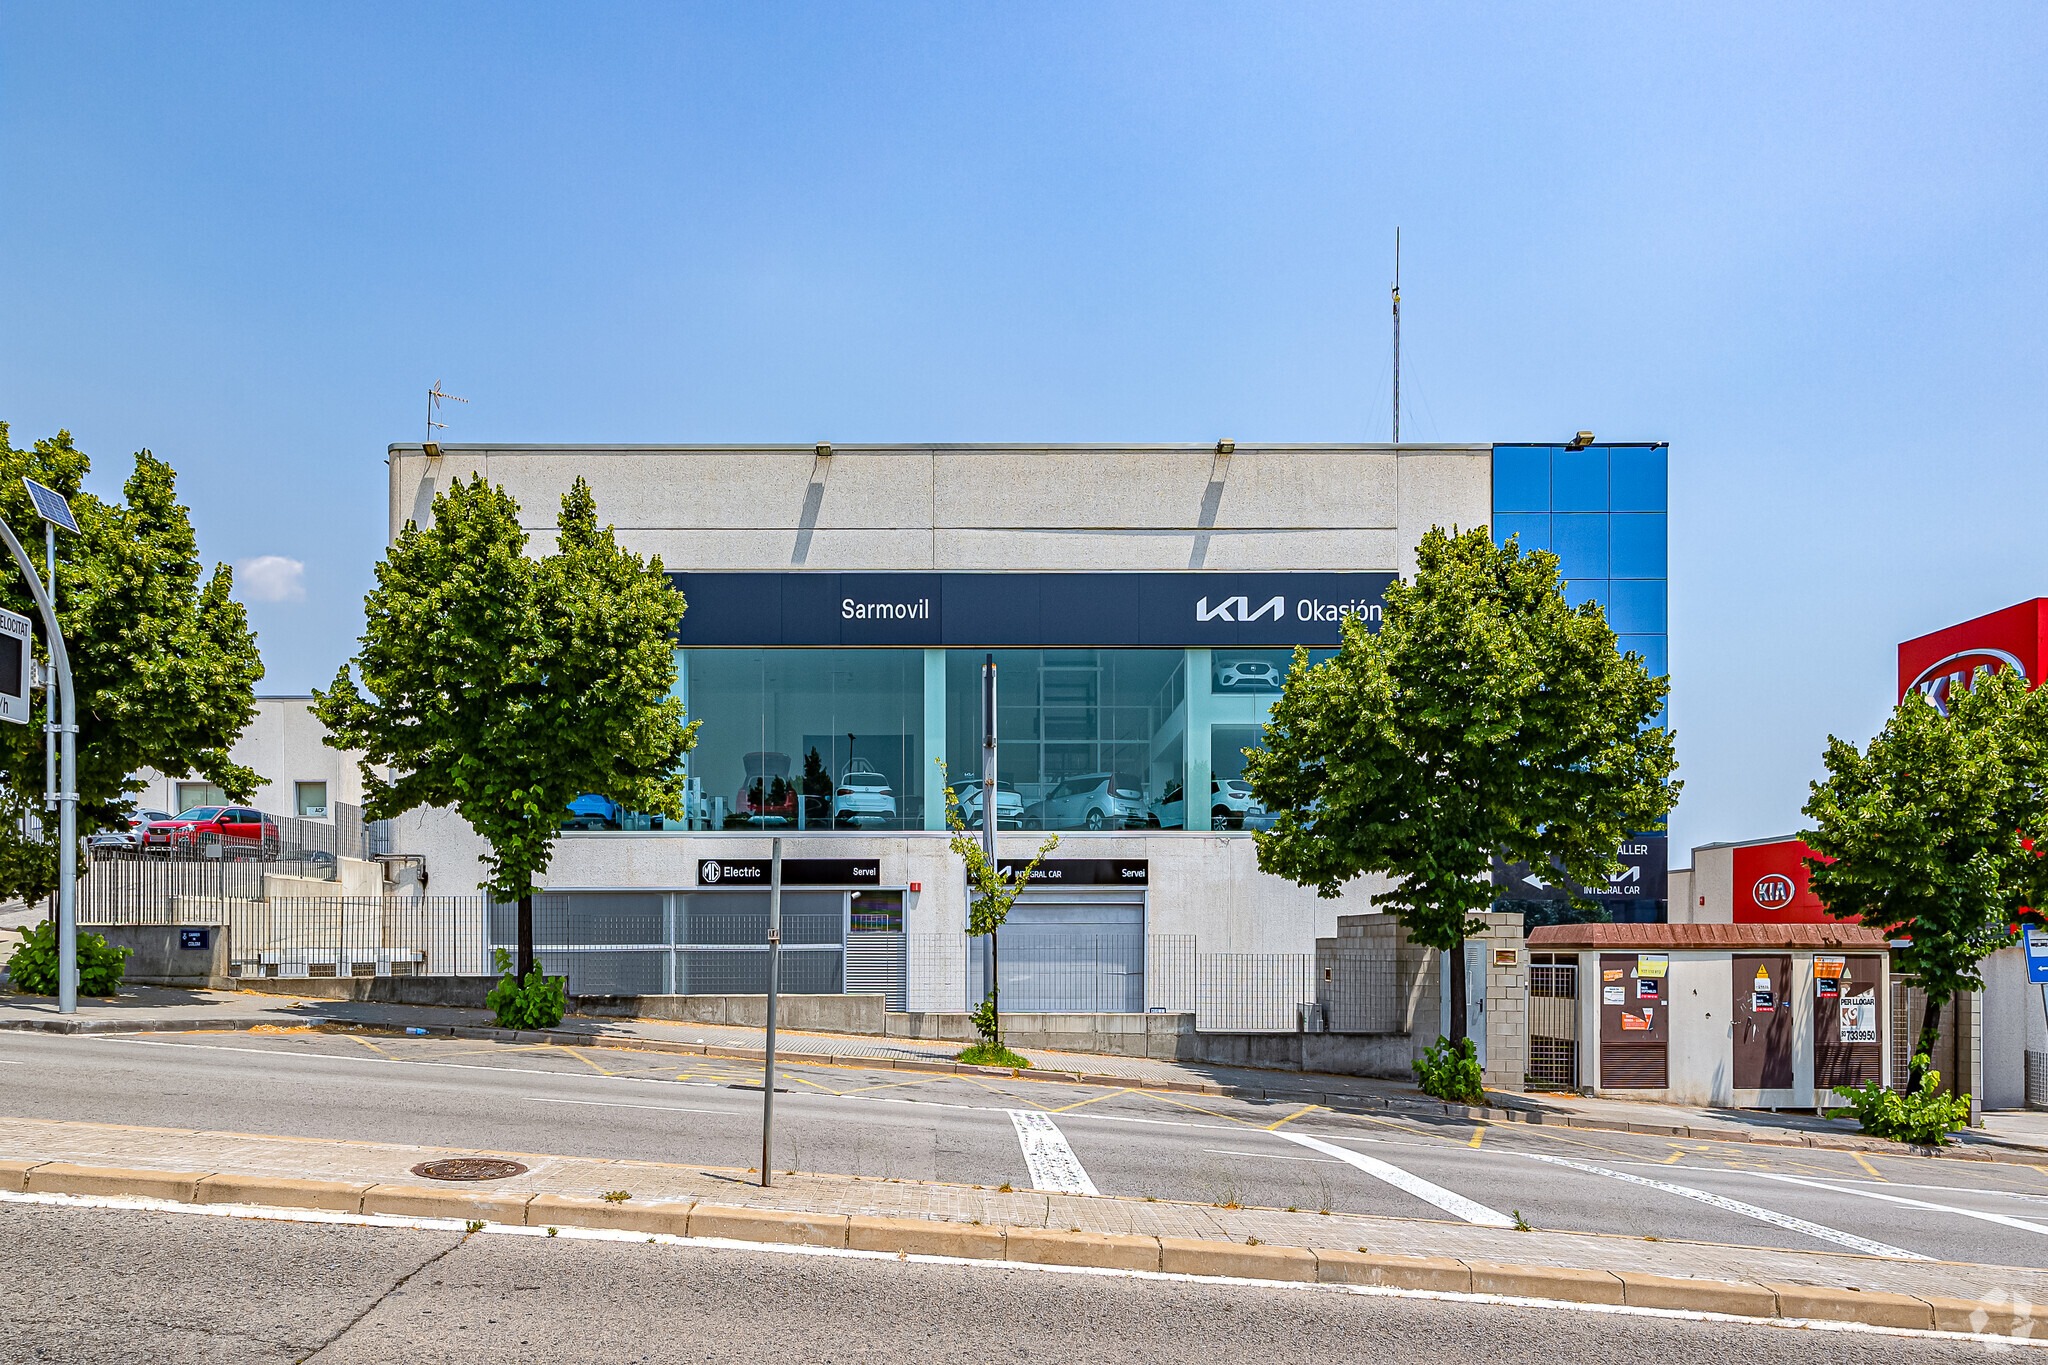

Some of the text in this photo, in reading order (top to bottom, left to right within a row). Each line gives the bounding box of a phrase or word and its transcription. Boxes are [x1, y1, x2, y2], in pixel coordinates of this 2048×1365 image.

[841, 598, 929, 619] Sarmovil
[1196, 596, 1382, 622] KIA Okasión
[1616, 844, 1648, 855] ALLER
[703, 862, 761, 882] MG Electric
[852, 867, 876, 876] Servei
[1015, 870, 1048, 878] INTGRAL
[1048, 870, 1062, 878] CAR
[1121, 868, 1146, 877] Servei
[1624, 885, 1640, 895] CAR
[1759, 882, 1787, 901] KIA
